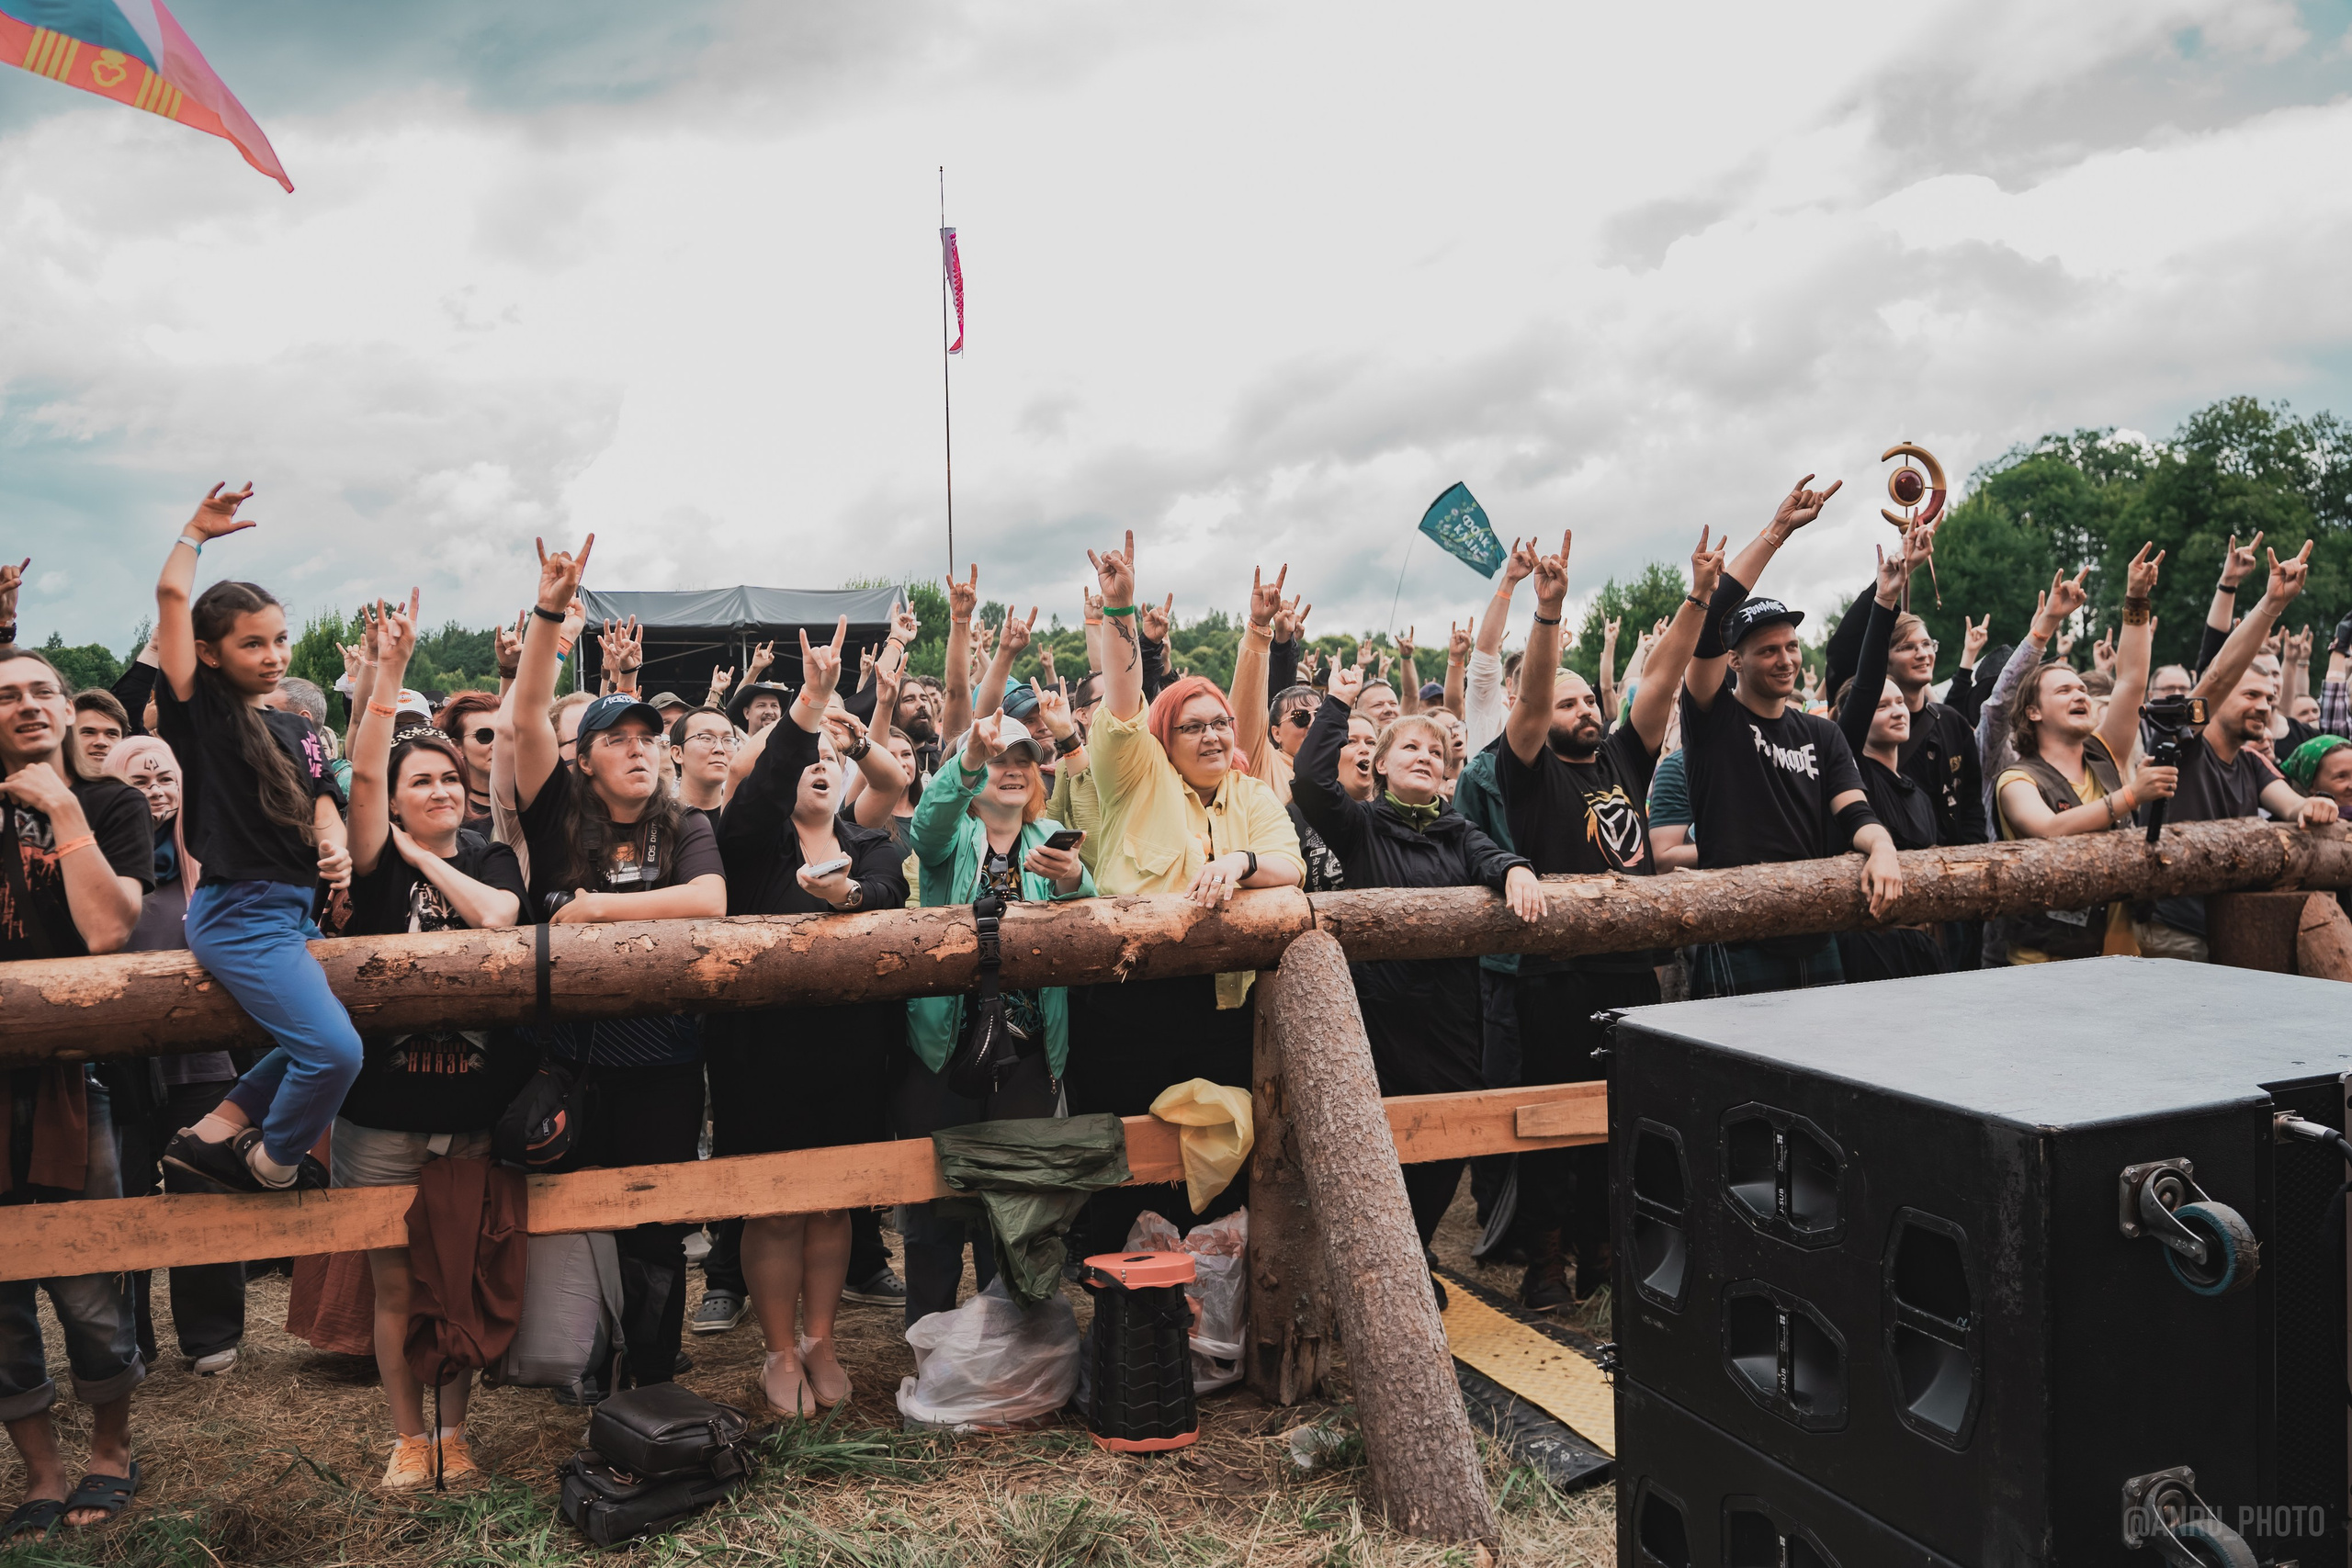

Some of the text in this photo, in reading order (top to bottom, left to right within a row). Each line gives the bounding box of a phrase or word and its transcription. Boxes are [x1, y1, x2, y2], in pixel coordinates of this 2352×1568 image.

[1463, 514, 1490, 548] ФОЛК
[1748, 724, 1819, 781] FMODE
[648, 845, 656, 863] EOS
[408, 1052, 469, 1074] КНЯЗЬ
